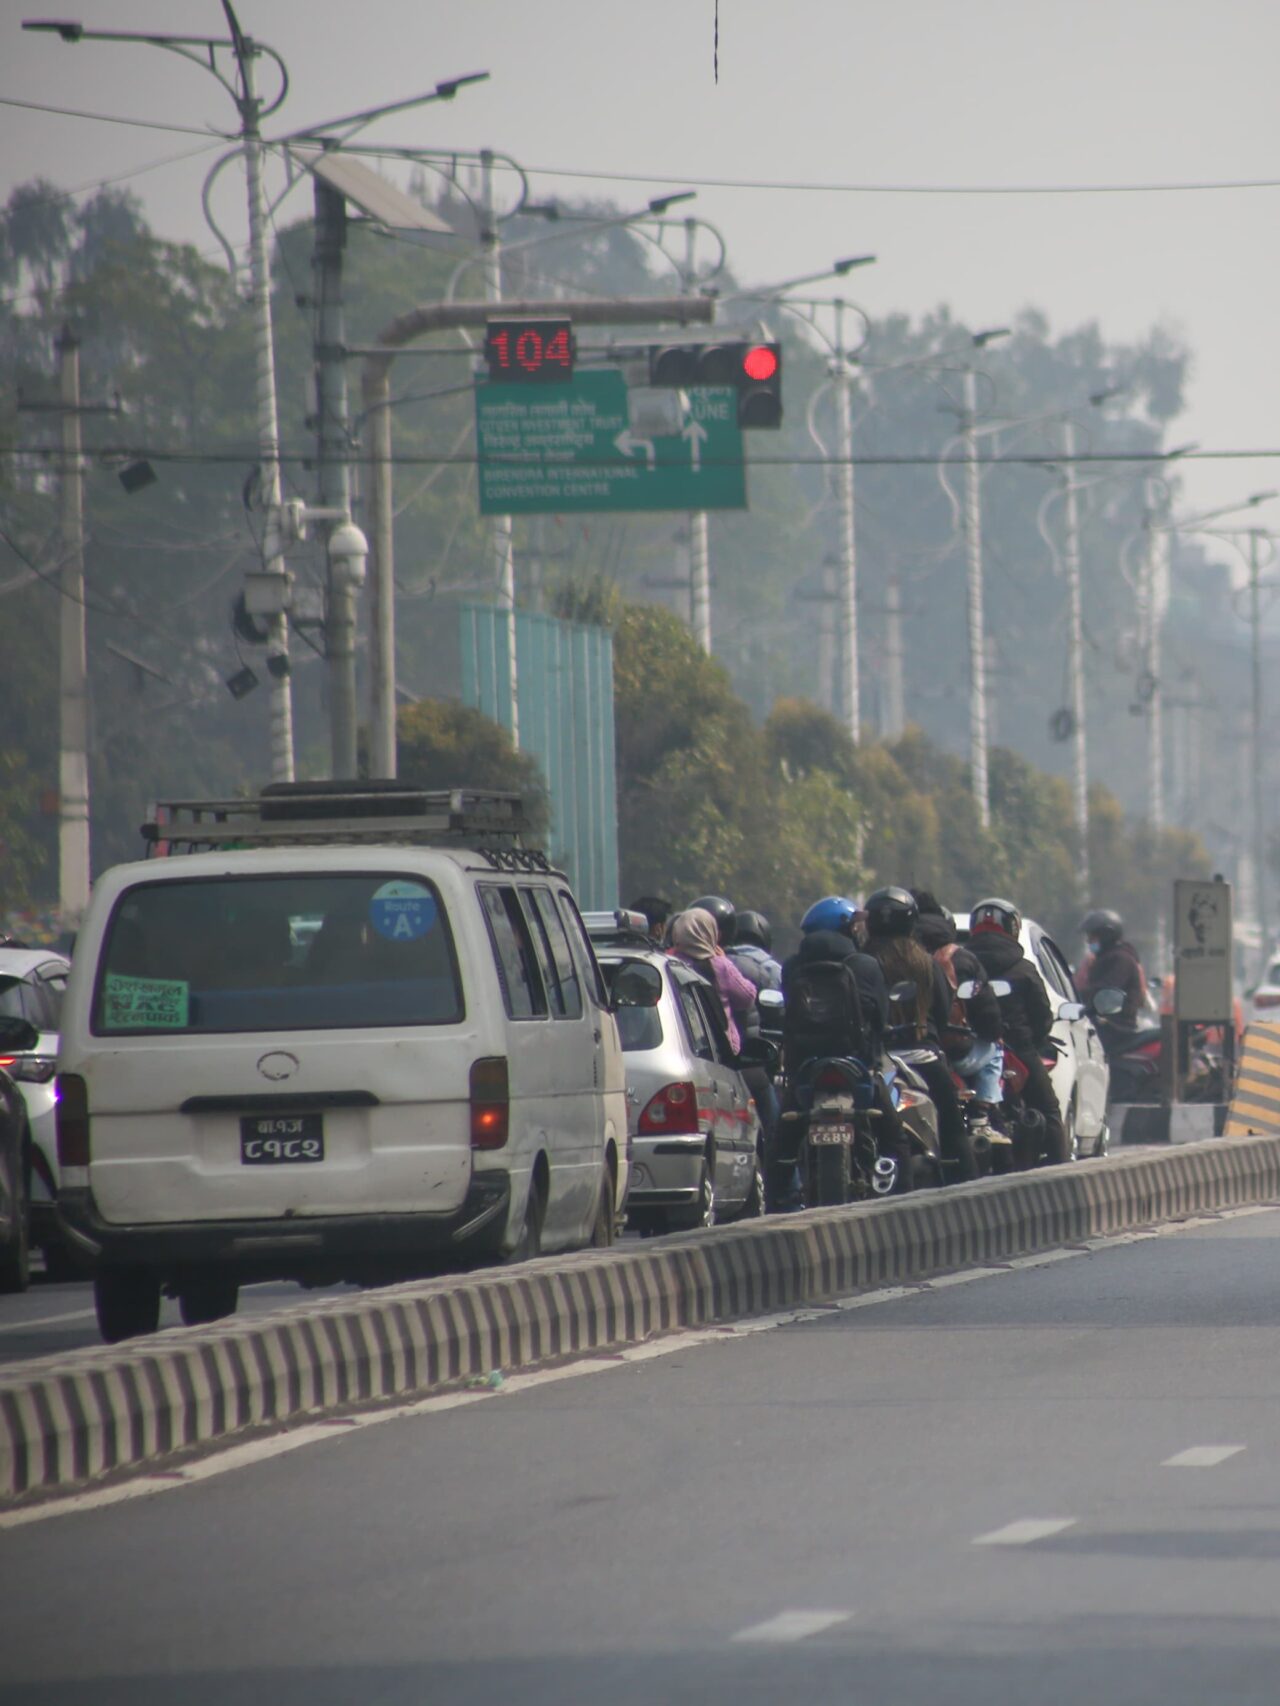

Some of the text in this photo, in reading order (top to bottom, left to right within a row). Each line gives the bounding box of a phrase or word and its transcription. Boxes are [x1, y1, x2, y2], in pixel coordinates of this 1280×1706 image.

[491, 330, 570, 371] 104
[590, 416, 623, 430] TRUST
[548, 466, 639, 480] INTERNATIONAL
[486, 483, 611, 499] CONVENTION CENTRE
[384, 901, 421, 912] Route
[393, 913, 413, 938] A
[244, 1140, 321, 1158] ८१८२
